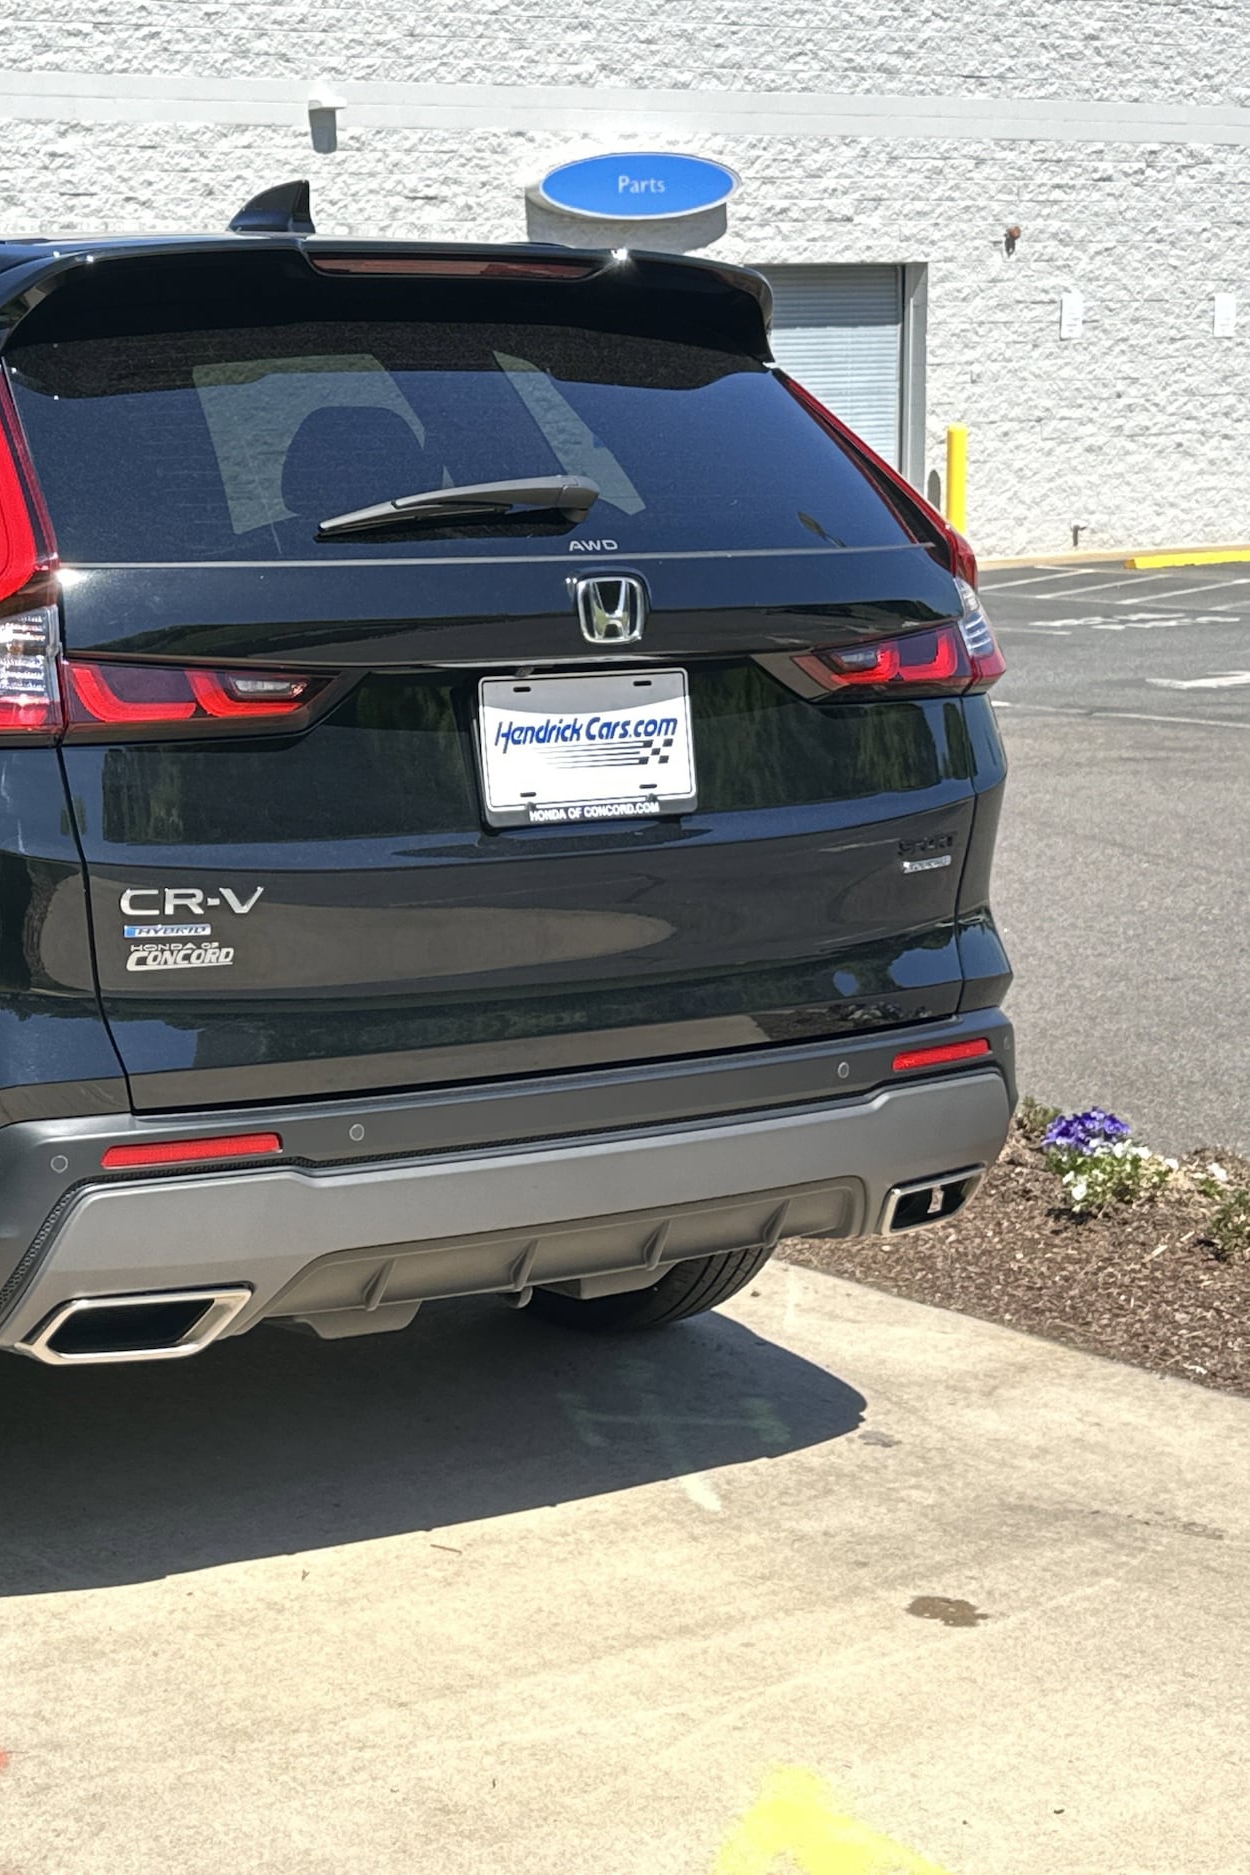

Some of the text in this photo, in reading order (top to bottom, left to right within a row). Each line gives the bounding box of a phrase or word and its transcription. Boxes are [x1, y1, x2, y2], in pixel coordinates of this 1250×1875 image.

[617, 175, 666, 194] Parts
[569, 540, 618, 551] AWD
[494, 717, 677, 754] Hendrick Cars.com
[529, 801, 660, 822] HONDA OF CONCORD.COM
[120, 887, 264, 915] CR-V
[138, 926, 207, 935] HYBRID
[130, 943, 197, 952] HONDA
[126, 948, 234, 971] CONCORD
